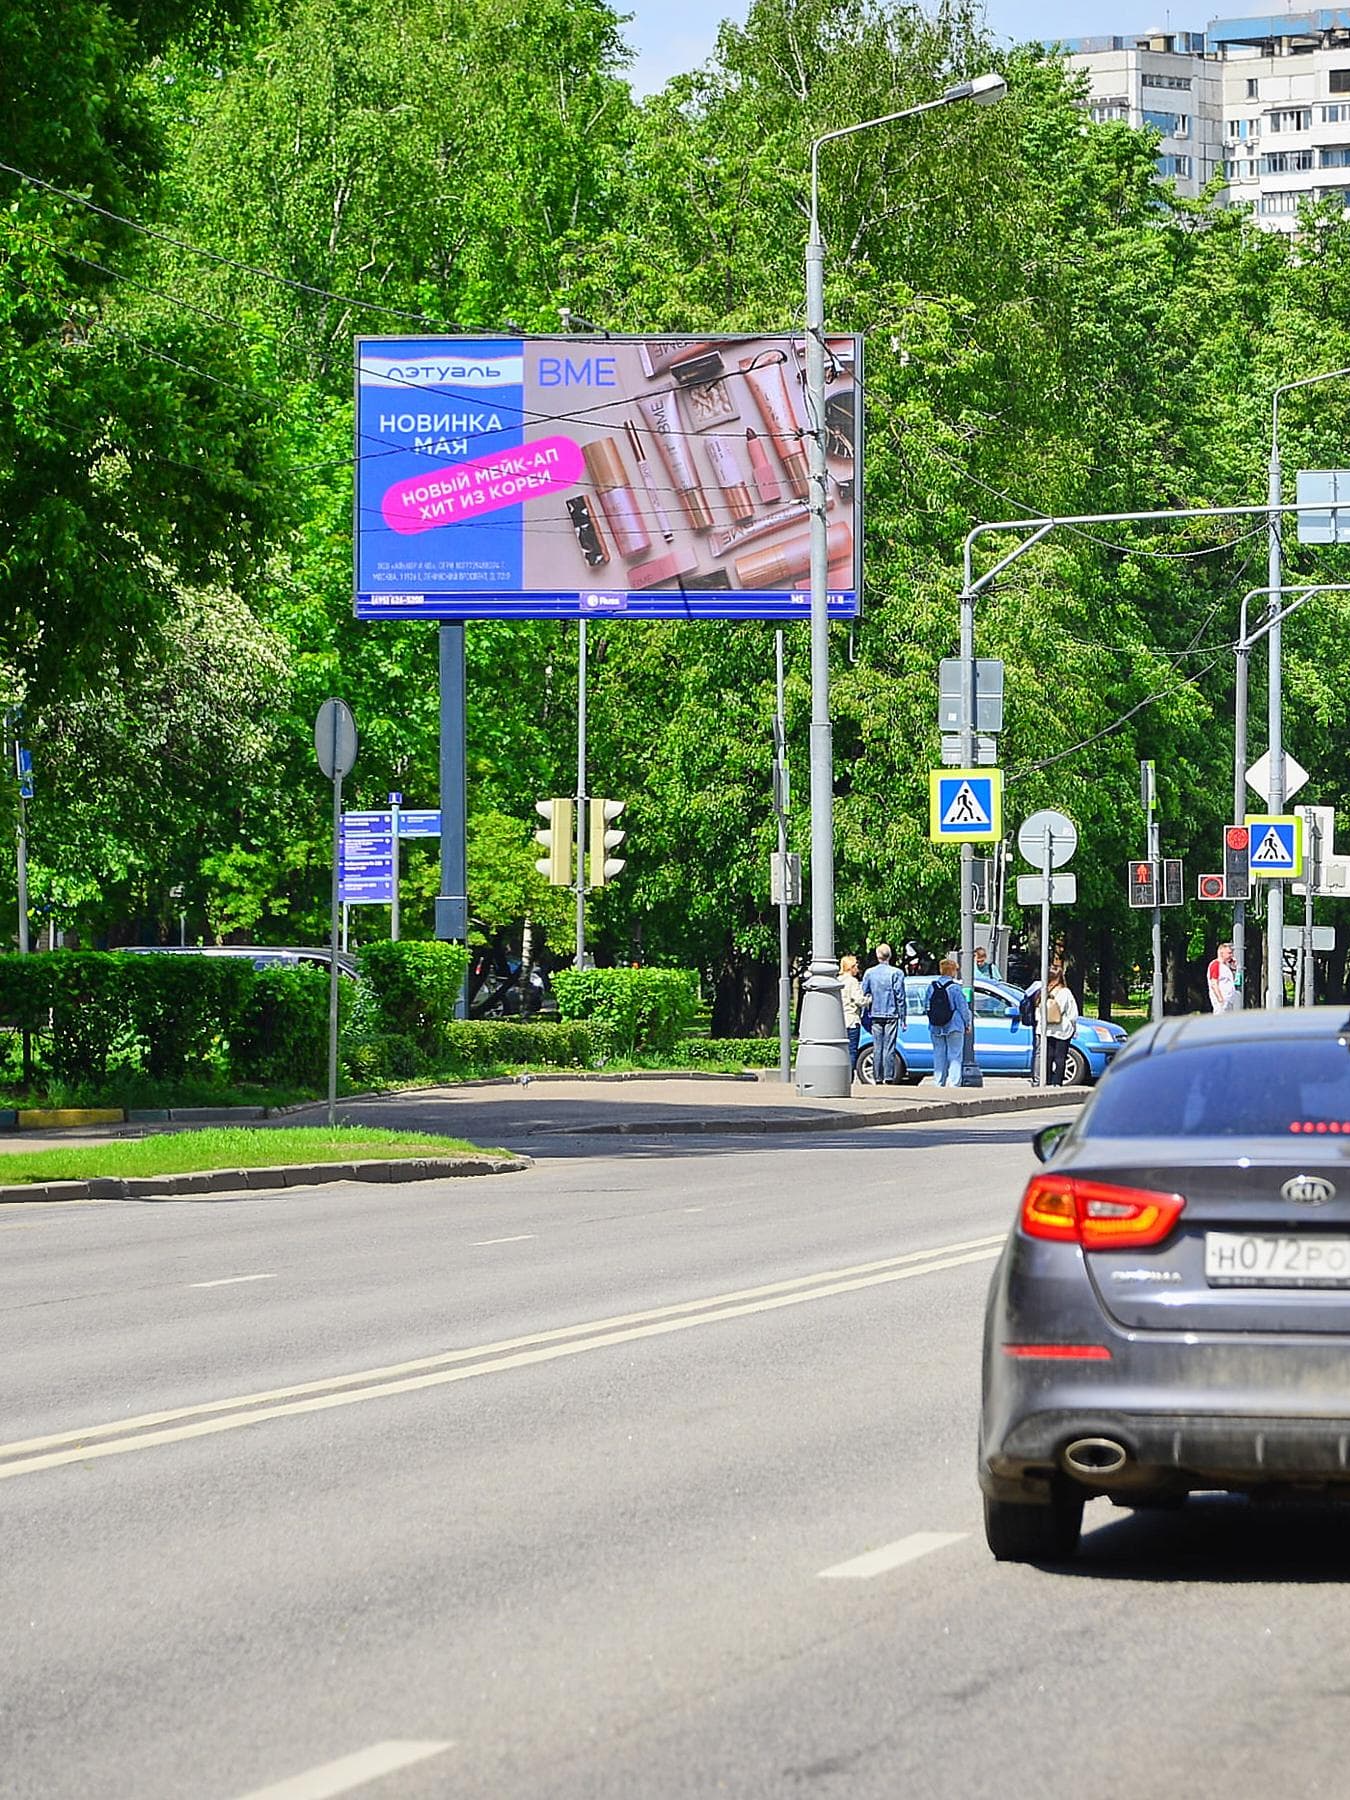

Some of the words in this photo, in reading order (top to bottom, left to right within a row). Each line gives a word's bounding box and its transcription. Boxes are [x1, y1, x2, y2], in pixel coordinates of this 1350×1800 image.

[538, 357, 617, 387] BME
[379, 413, 503, 433] НОВИНКА
[413, 436, 468, 455] МАЯ
[401, 471, 471, 508] НОВЫЙ
[474, 447, 560, 484] МЕЙК-АП
[418, 497, 455, 522] ХИТ
[460, 488, 486, 511] ИЗ
[1288, 1184, 1328, 1201] KIA
[1218, 1237, 1346, 1271] Н072РО
